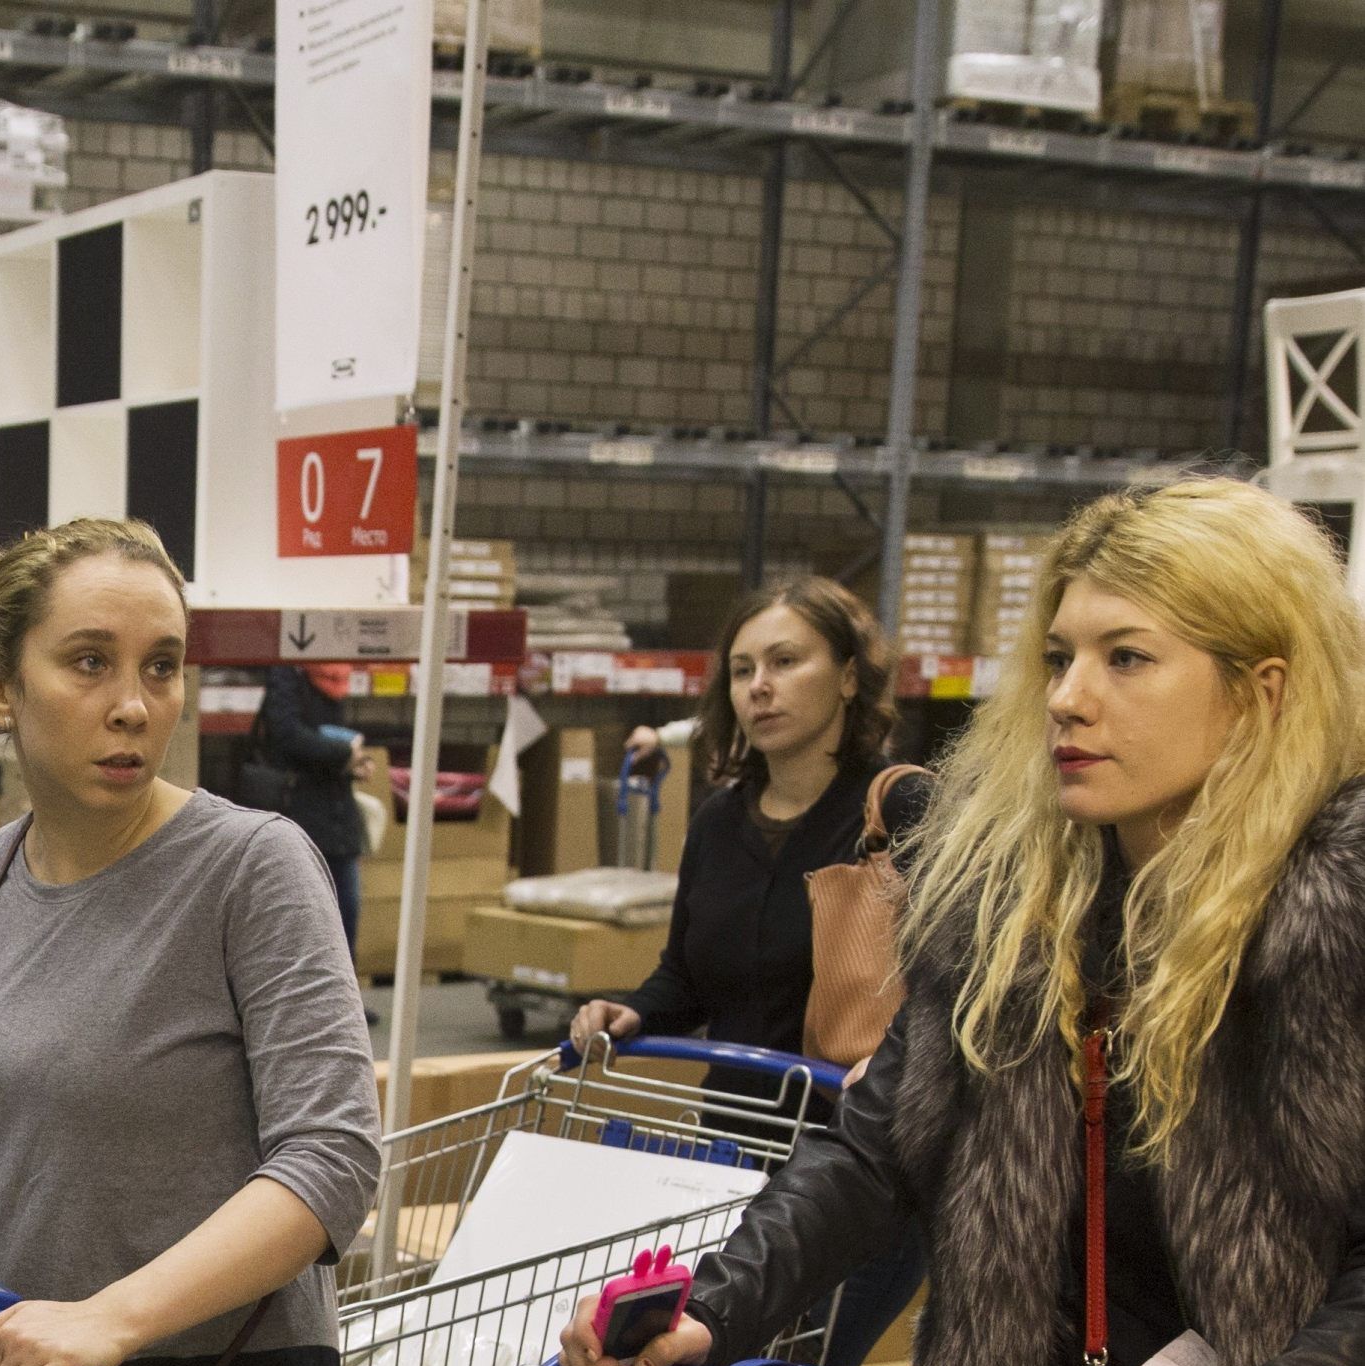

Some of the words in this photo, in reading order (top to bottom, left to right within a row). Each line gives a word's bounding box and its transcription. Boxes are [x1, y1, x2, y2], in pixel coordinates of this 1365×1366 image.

[305, 203, 320, 246] 2
[300, 450, 326, 524] 0
[356, 447, 383, 520] 7
